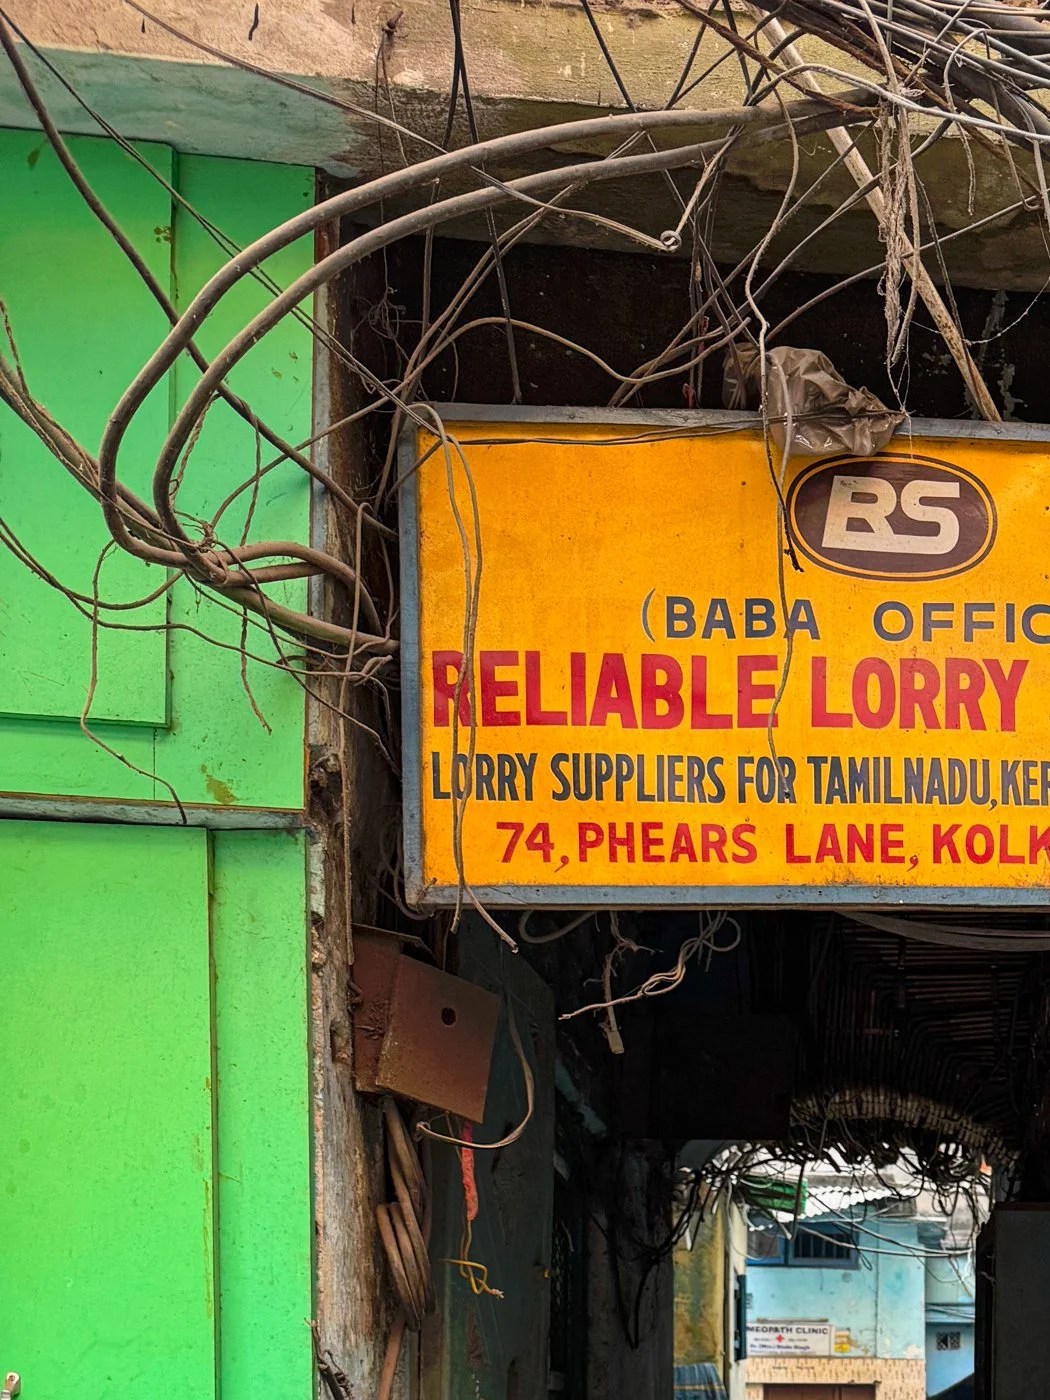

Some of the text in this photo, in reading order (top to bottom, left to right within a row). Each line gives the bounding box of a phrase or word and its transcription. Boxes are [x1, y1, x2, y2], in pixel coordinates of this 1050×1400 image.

[641, 588, 820, 642] (BABA
[432, 650, 778, 730] RELIABLE
[811, 656, 1029, 732] LORRY
[431, 752, 537, 801] LORRY
[551, 753, 726, 804] SUPPLIERS
[737, 756, 796, 804] FOR
[796, 1326, 828, 1335] CLINIC
